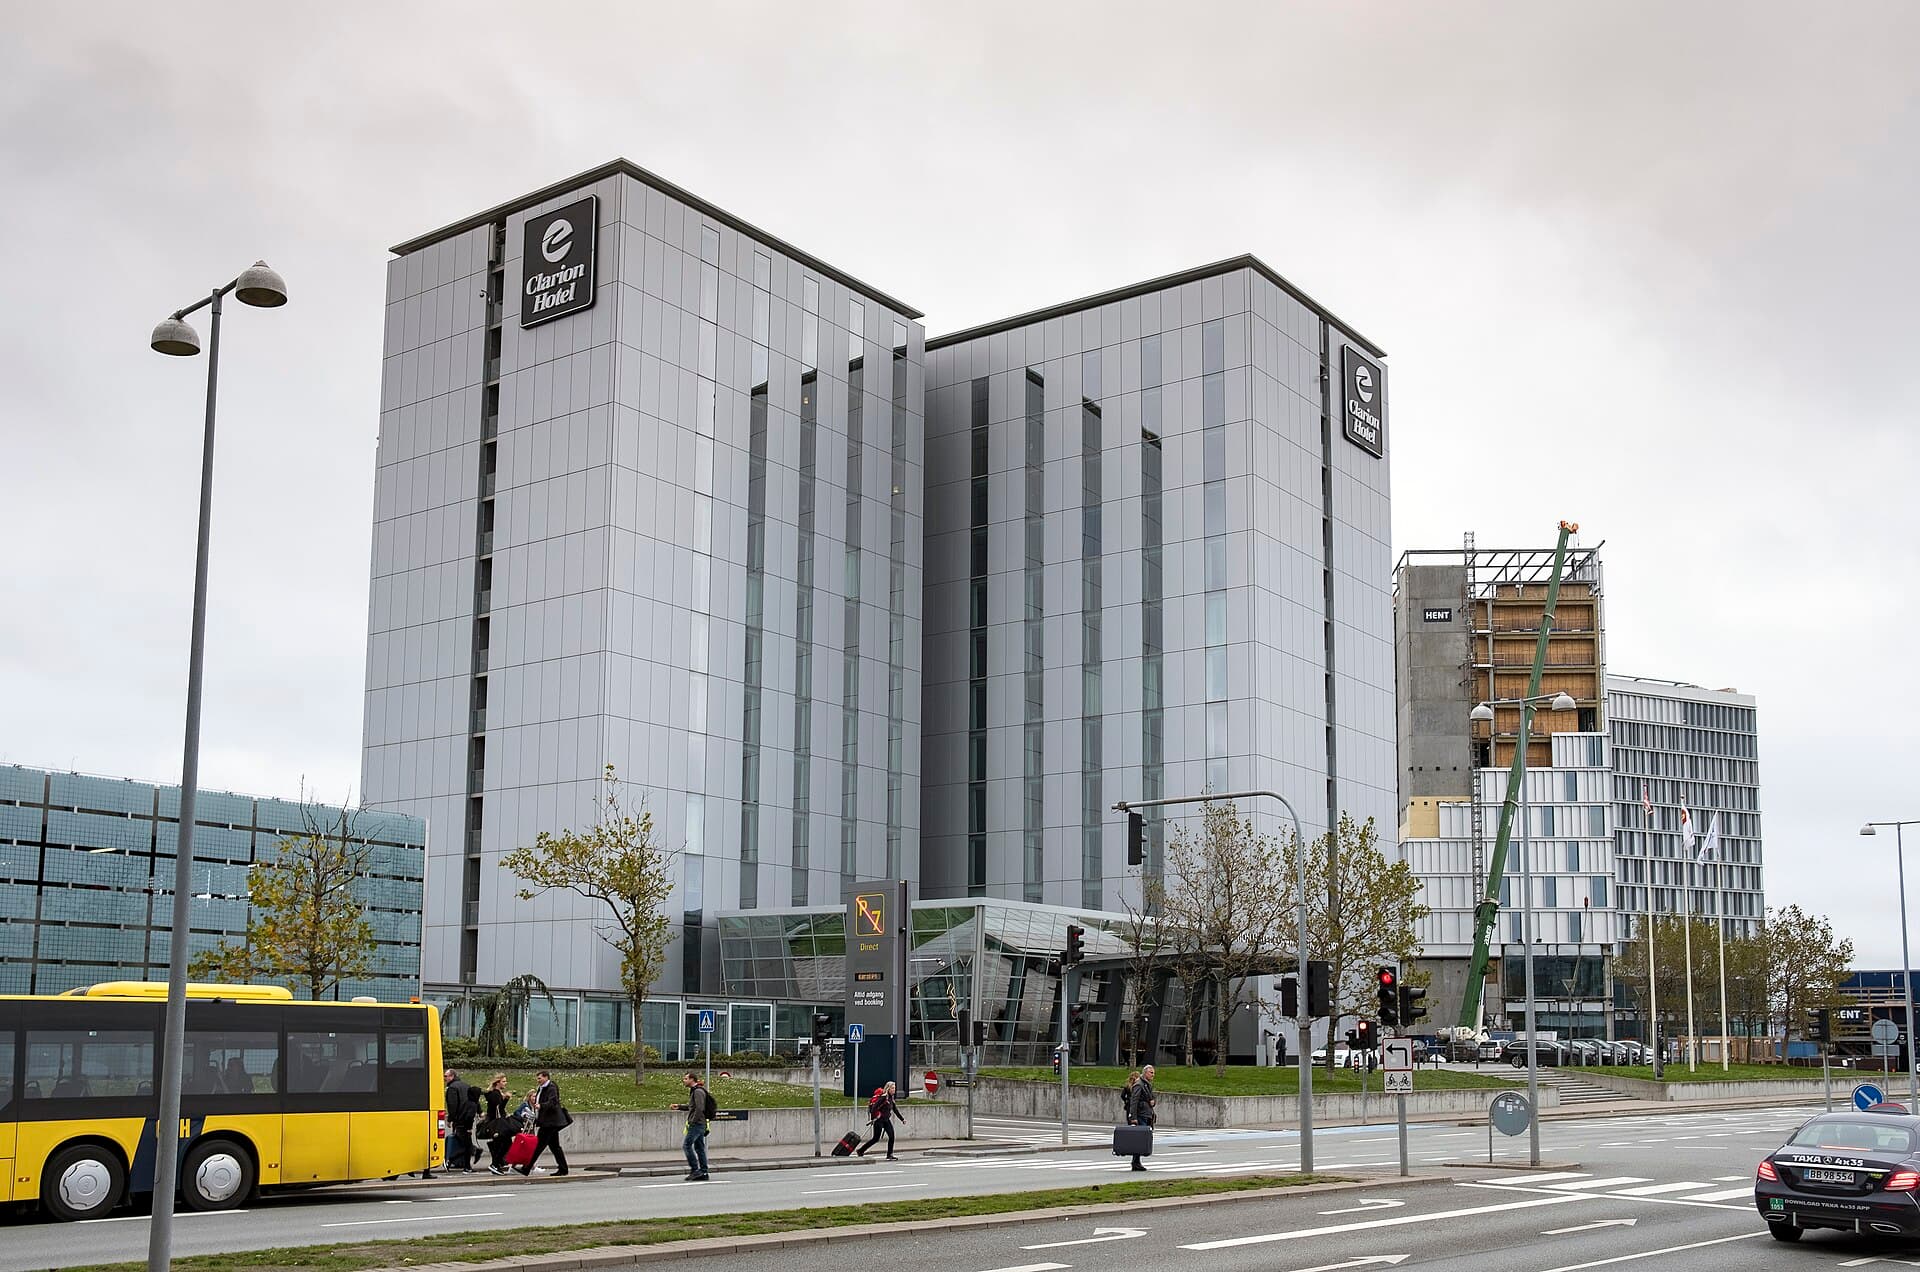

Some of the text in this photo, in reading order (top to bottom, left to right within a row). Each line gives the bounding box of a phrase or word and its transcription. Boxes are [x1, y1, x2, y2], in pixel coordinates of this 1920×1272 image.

[526, 264, 585, 295] Clarion
[532, 282, 577, 314] Hotel
[1349, 399, 1380, 430] Clarion
[1353, 419, 1376, 444] Hotel
[1425, 611, 1450, 619] HENT
[860, 943, 879, 951] Direct
[866, 991, 884, 999] adgang
[1832, 1010, 1860, 1019] ENT
[1792, 1154, 1864, 1167] TAXA 4x35
[1810, 1170, 1822, 1178] BB
[1823, 1171, 1835, 1180] 98
[1784, 1199, 1820, 1207] DOWNLOAD
